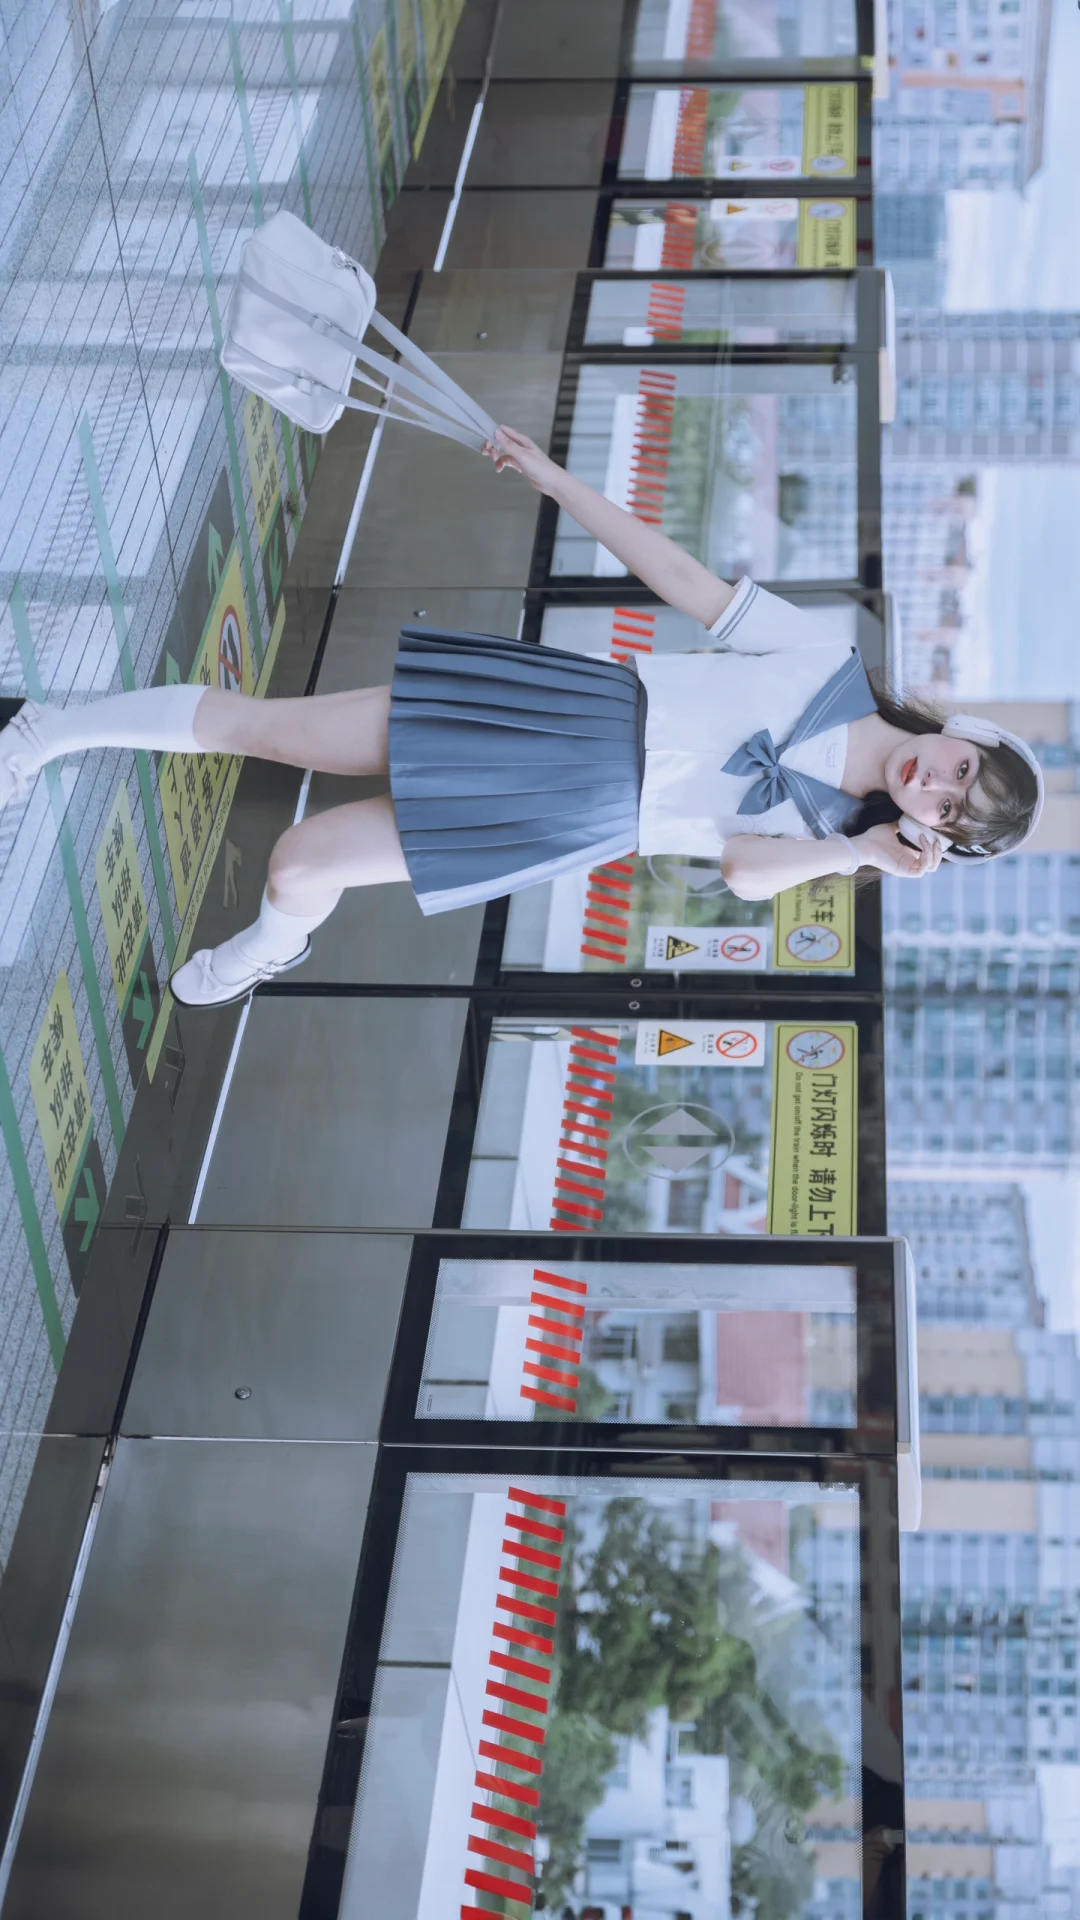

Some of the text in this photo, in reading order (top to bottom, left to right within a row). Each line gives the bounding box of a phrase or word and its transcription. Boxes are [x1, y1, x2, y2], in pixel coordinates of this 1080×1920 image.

[215, 788, 230, 838] Please
[104, 811, 124, 884] 候车
[203, 838, 216, 875] mind
[111, 857, 132, 928] 排队
[195, 876, 204, 902] the
[115, 891, 143, 986] 请在此
[40, 1004, 64, 1084] 候车
[49, 1050, 73, 1130] 排队
[795, 1072, 803, 1080] Do
[793, 1094, 801, 1103] get
[810, 1073, 837, 1157] 门灯闪烁时
[54, 1084, 86, 1191] 请在此
[793, 1138, 801, 1153] train
[794, 1126, 802, 1136] the
[792, 1155, 800, 1171] when
[792, 1174, 801, 1184] the
[789, 1187, 799, 1219] door-light
